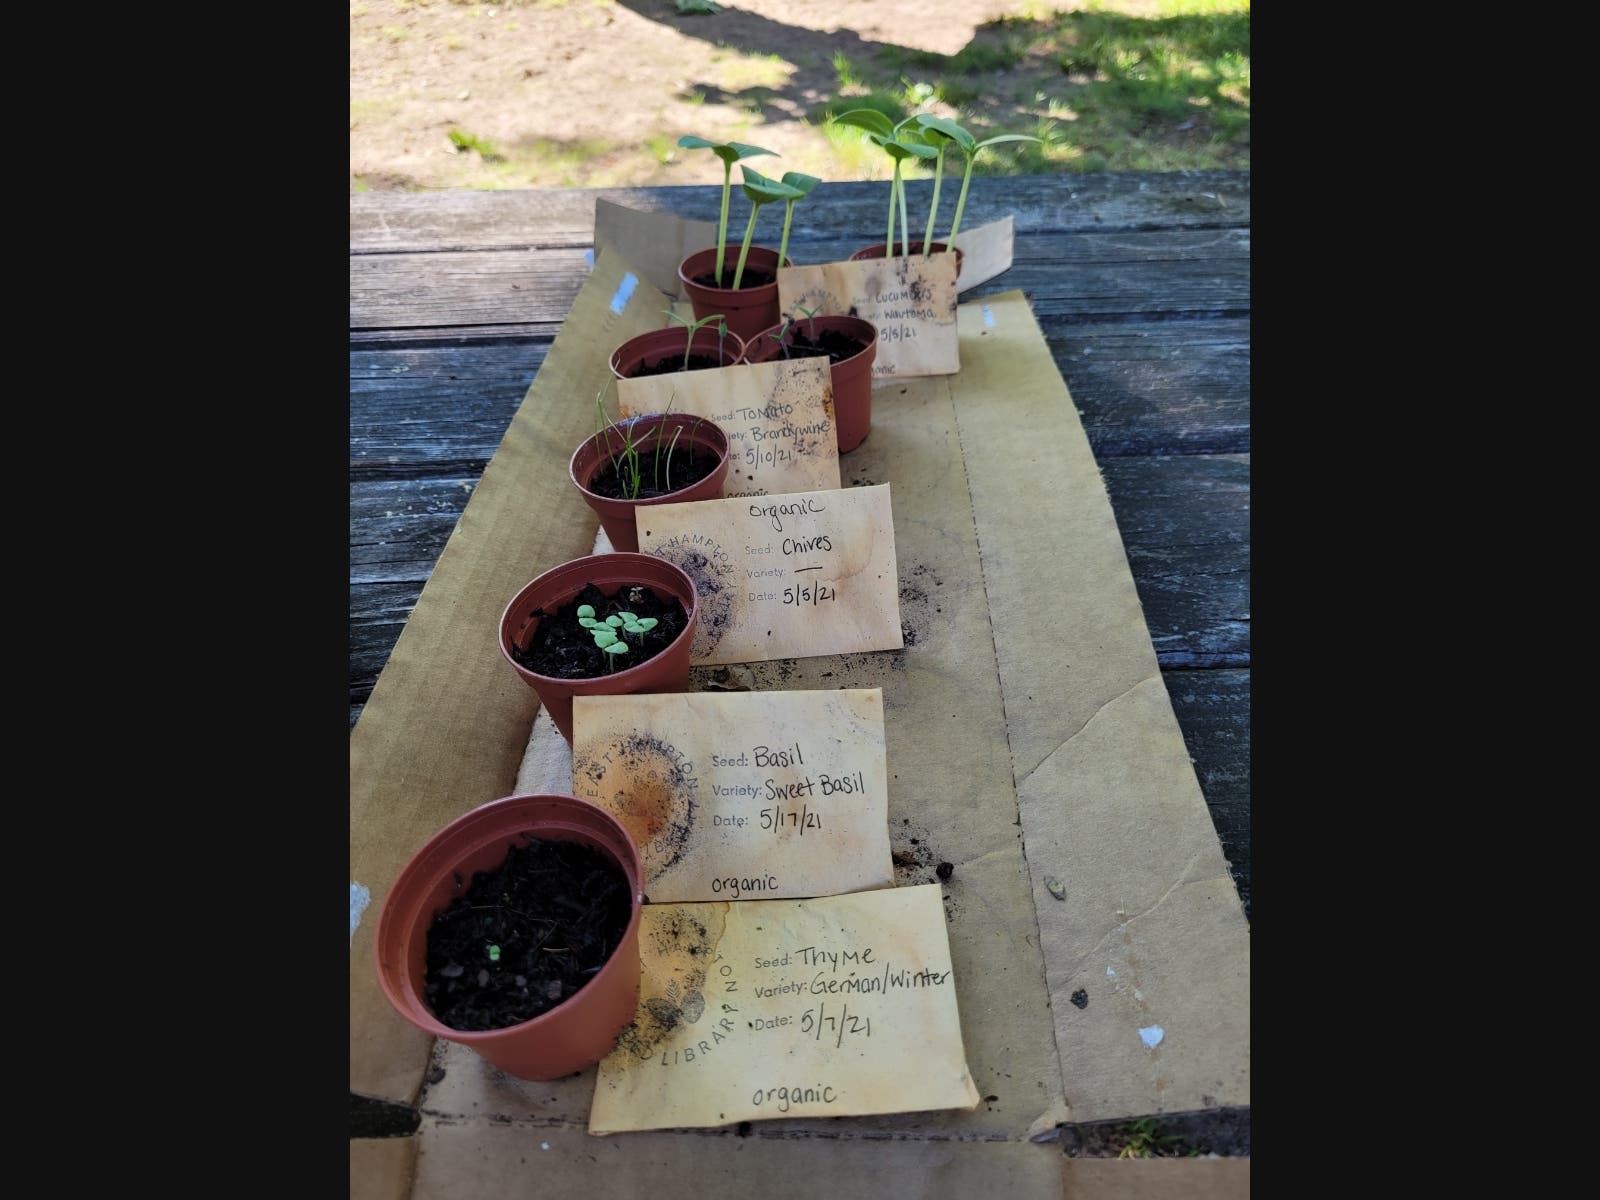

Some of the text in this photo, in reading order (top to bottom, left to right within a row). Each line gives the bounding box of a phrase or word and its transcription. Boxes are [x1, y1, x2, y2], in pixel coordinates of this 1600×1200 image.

[728, 432, 748, 441] iety:
[746, 443, 792, 470] 5/10/21
[749, 498, 826, 533] organic
[744, 535, 833, 556] Seed: Chives
[746, 566, 787, 579] Variety:
[748, 580, 836, 607] Date: 5/5/21
[711, 743, 804, 768] Seed: Basil
[712, 771, 865, 801] Variety: Sweet Basil
[713, 803, 822, 836] Date: 5/17/21
[711, 874, 780, 899] organic
[754, 953, 793, 969] Seed:
[754, 981, 808, 999] Variety:
[660, 1003, 740, 1067] LIBRARY
[754, 1002, 871, 1049] Date: 5/7/21
[752, 1083, 838, 1112] organic
